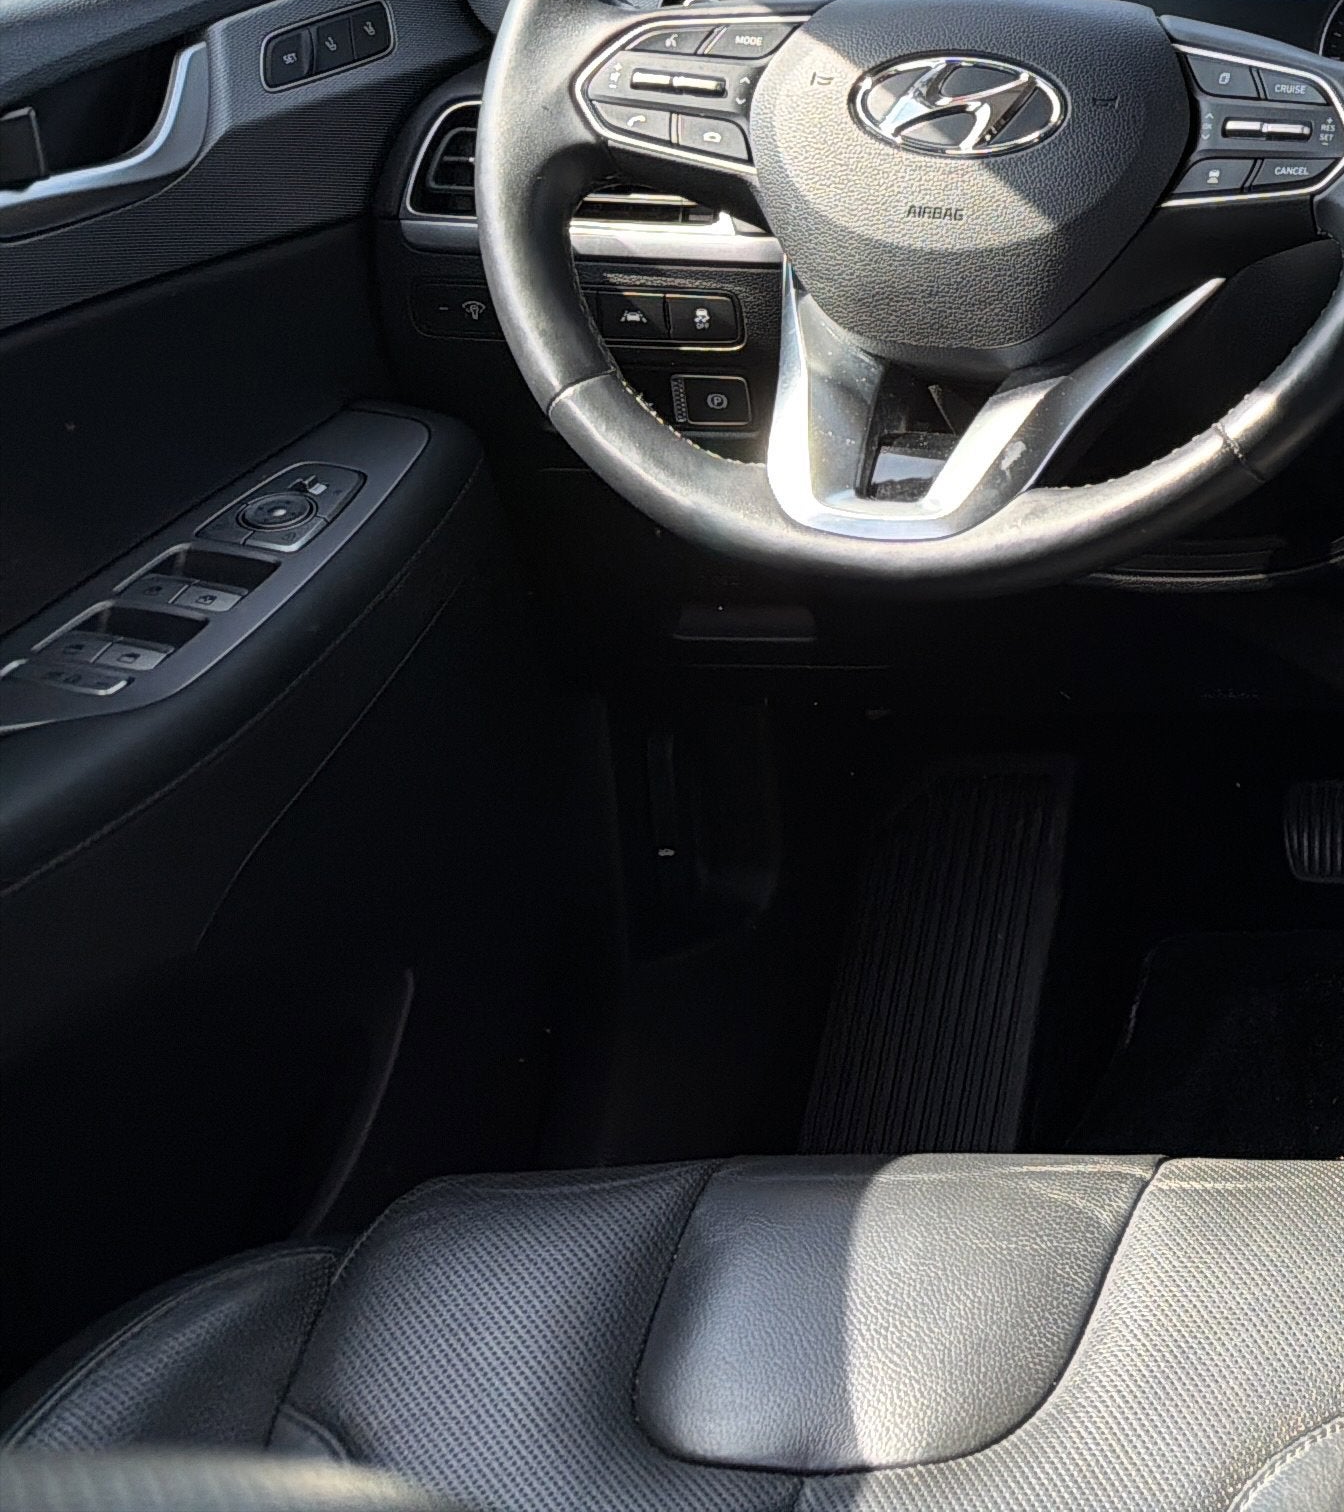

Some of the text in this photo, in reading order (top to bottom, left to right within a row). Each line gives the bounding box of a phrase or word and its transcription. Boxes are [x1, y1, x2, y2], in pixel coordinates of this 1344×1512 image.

[735, 35, 763, 47] MODE
[1274, 83, 1307, 95] CRUISE
[1274, 166, 1310, 176] CANCEL
[906, 204, 964, 221] AIRBAG
